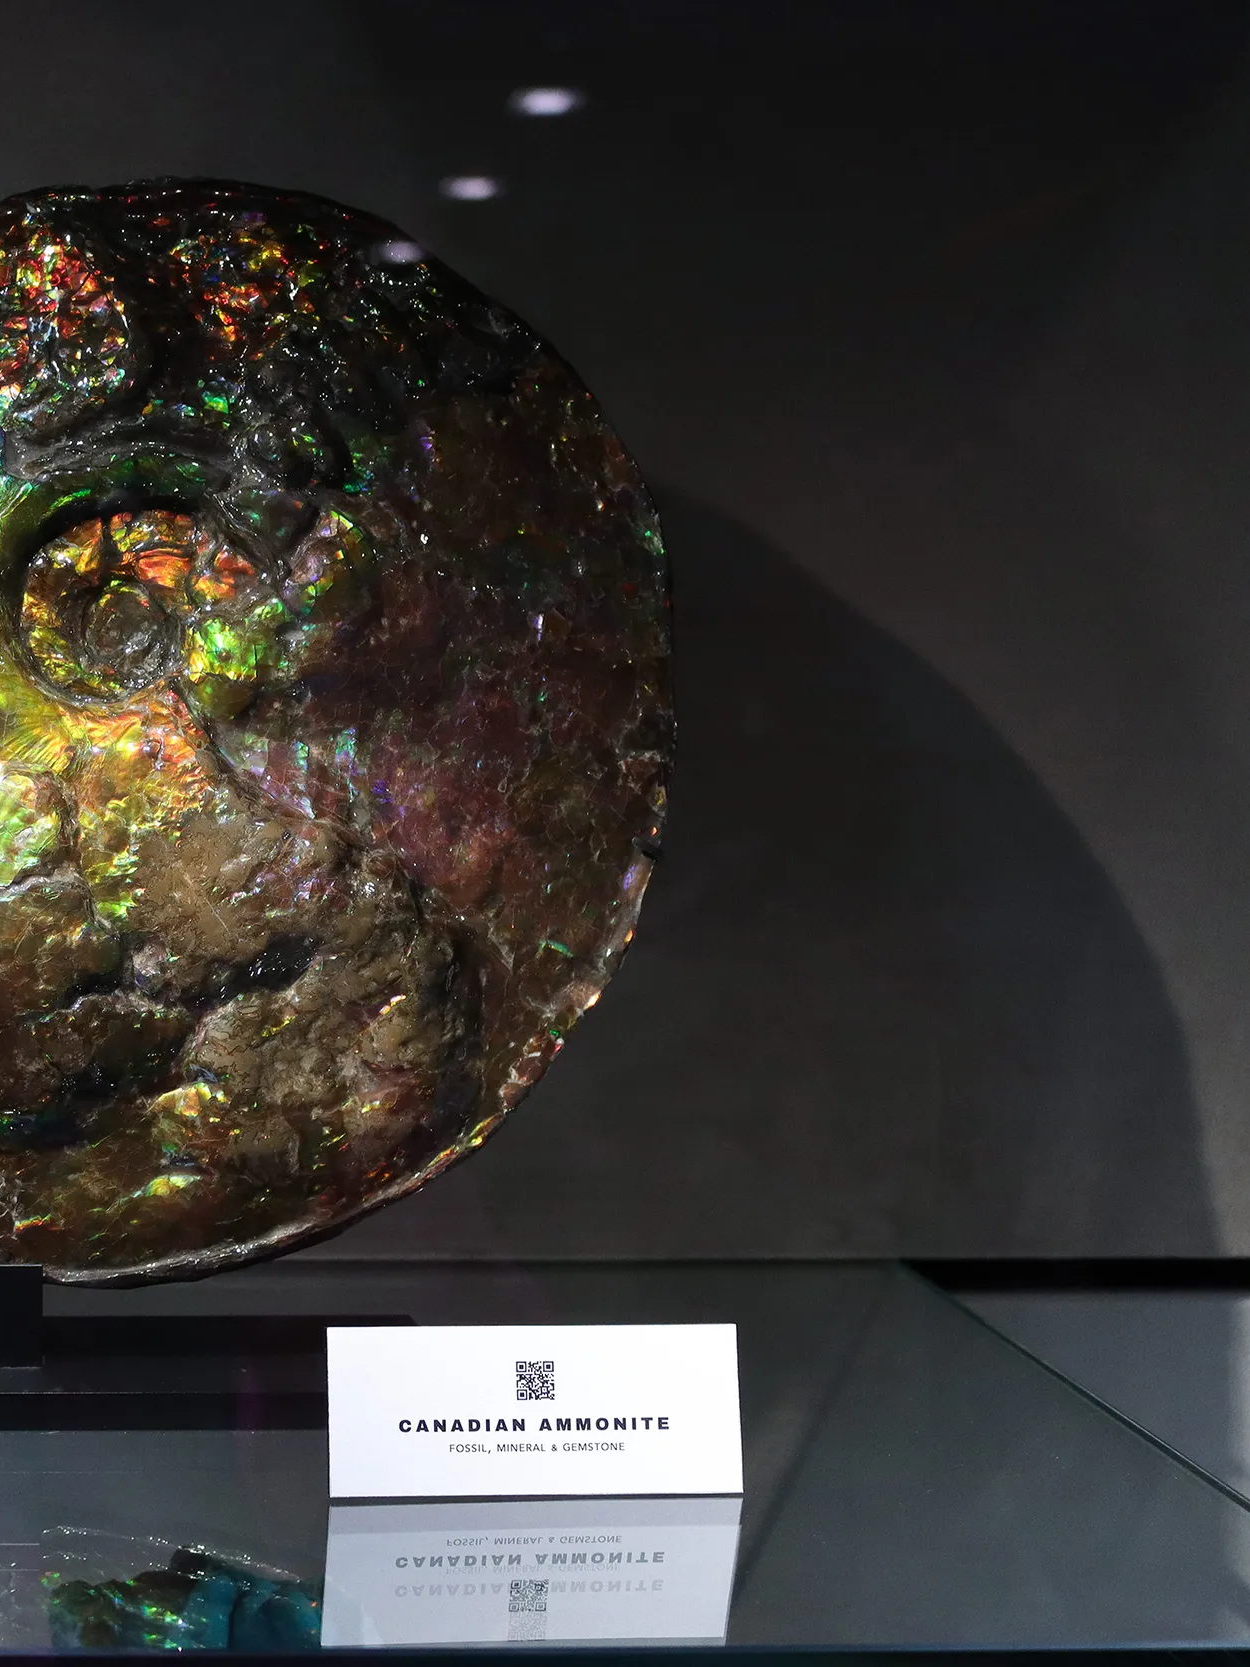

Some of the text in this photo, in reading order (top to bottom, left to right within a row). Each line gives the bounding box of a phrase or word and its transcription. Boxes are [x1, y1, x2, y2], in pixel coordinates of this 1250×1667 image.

[398, 1416, 670, 1433] CANADIAN AMMONITE
[449, 1442, 625, 1454] FOSSIL, MINERAL & GEMSTONE
